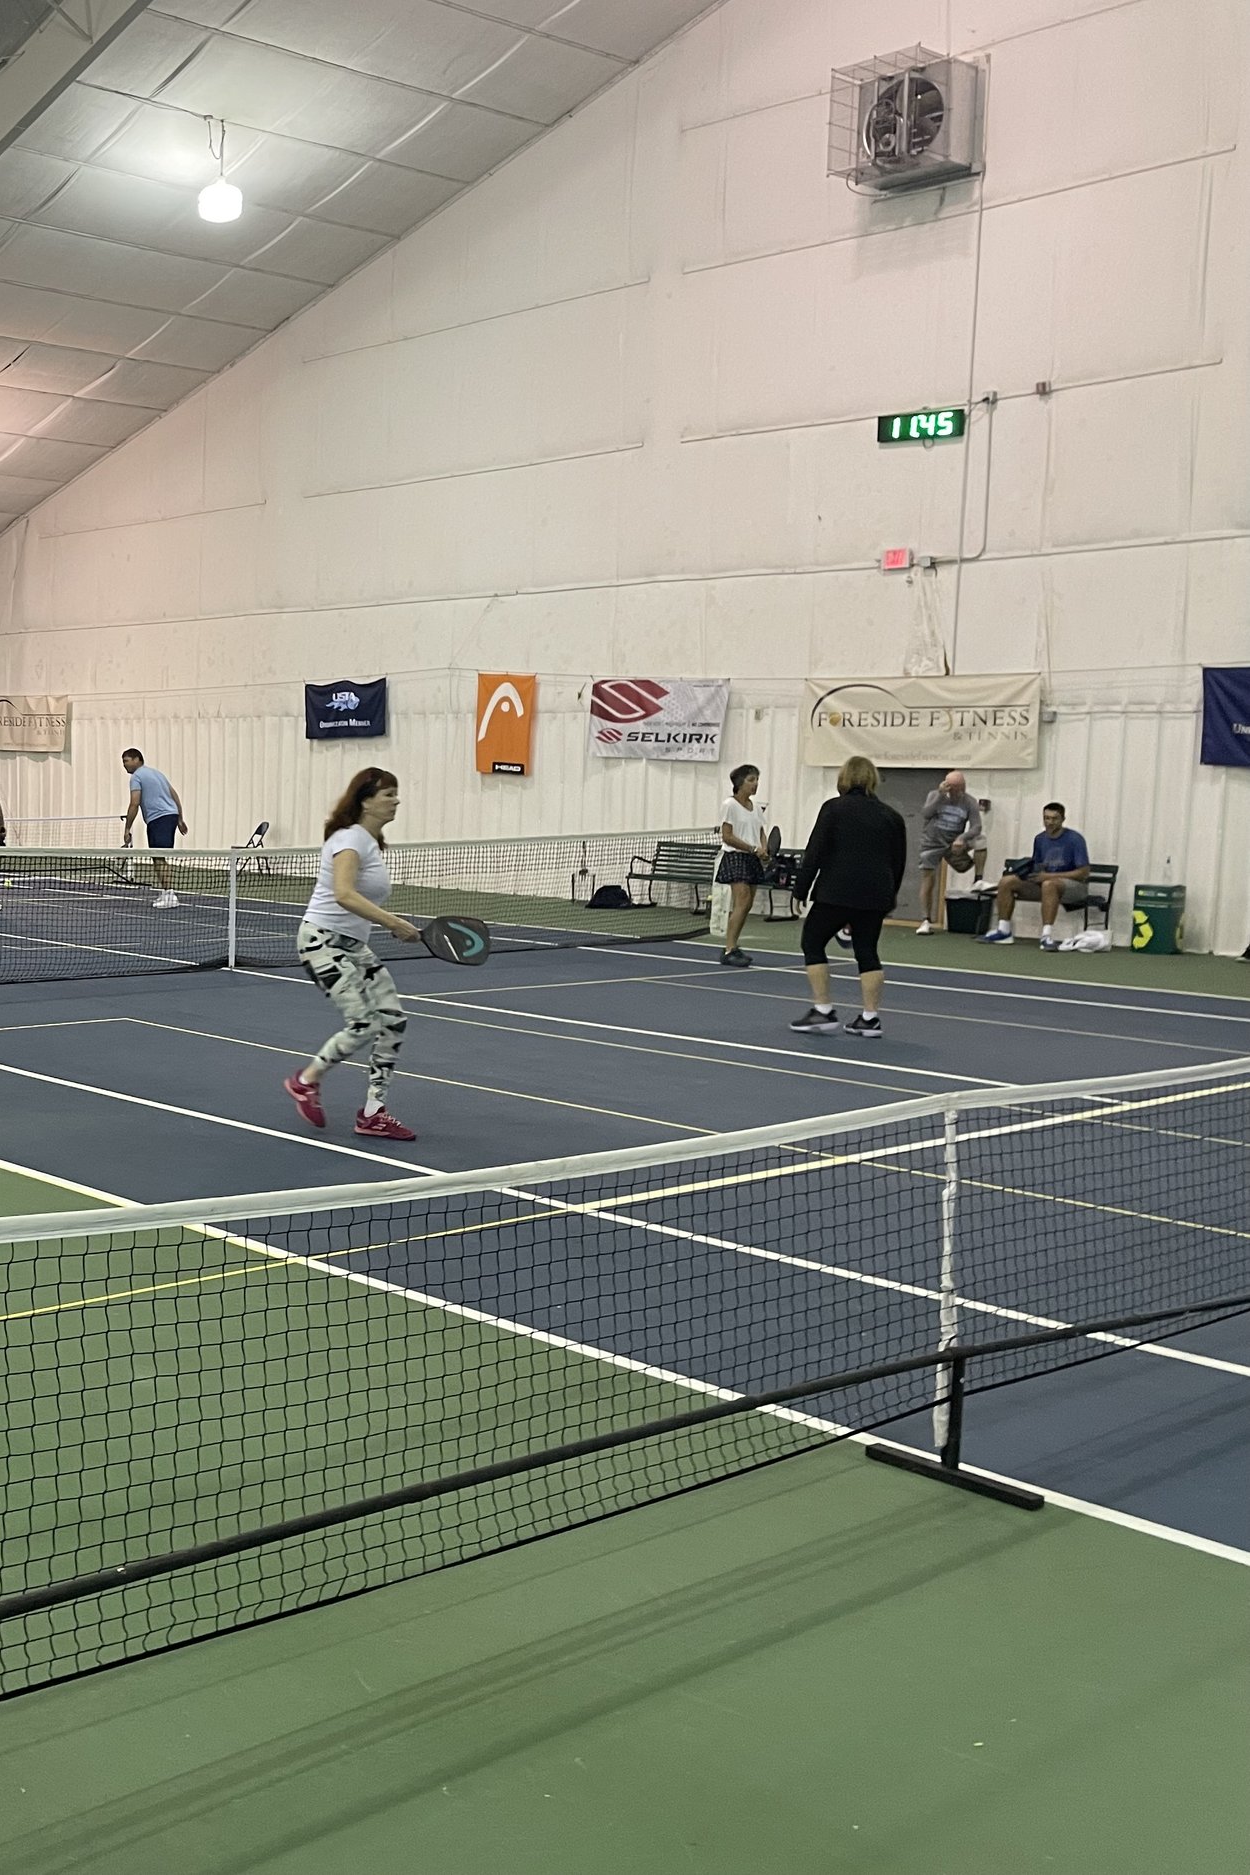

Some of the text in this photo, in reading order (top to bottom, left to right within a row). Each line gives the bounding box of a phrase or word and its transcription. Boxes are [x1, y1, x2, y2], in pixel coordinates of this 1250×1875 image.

[332, 691, 356, 702] USTA
[626, 731, 719, 744] SELKIRK
[952, 731, 963, 741] &
[494, 764, 522, 772] HEAD
